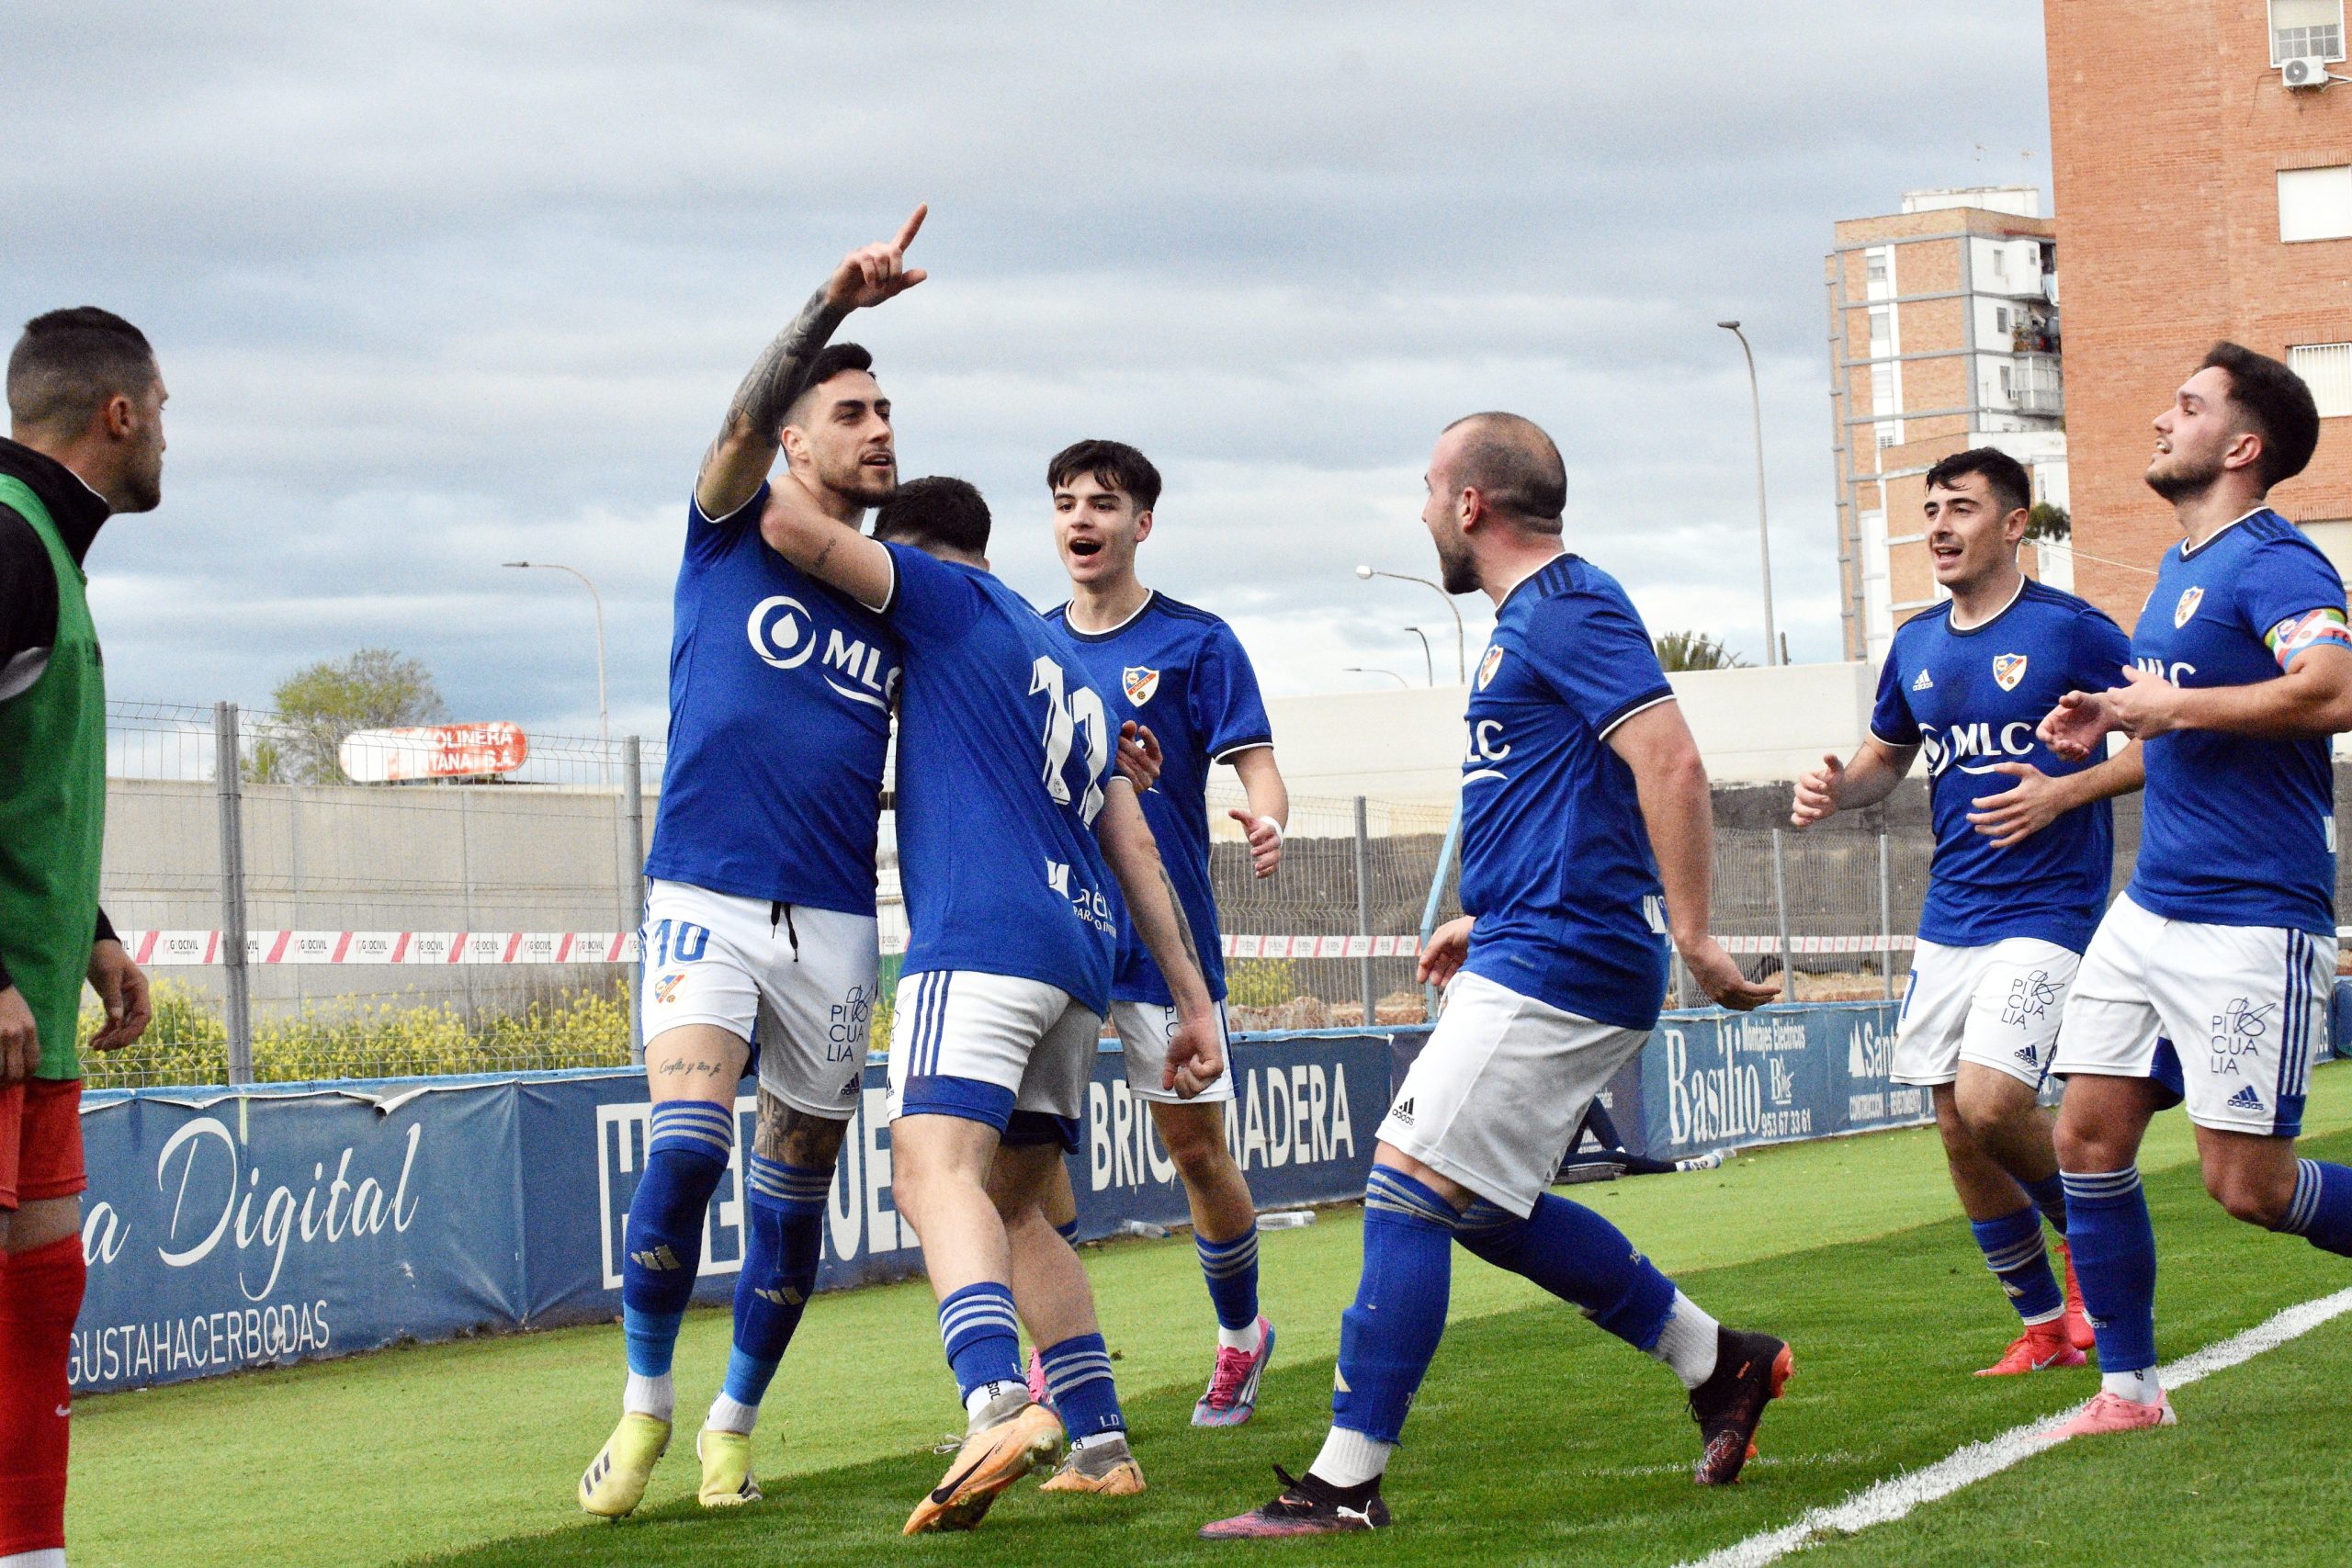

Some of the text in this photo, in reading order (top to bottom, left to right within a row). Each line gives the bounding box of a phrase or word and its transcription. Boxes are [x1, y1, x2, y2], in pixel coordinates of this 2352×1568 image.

[434, 727, 514, 749] OLINERA
[1028, 654, 1108, 831] 11
[1465, 719, 1511, 761] LC
[1951, 722, 2035, 757] MLC
[654, 919, 710, 967] 10
[2012, 978, 2028, 994] PI
[2001, 1008, 2027, 1030] LIA
[2008, 994, 2045, 1021] CUA
[2212, 1015, 2227, 1033] PI
[827, 1043, 854, 1062] LIA
[1864, 1021, 1894, 1078] Sant
[2211, 1035, 2259, 1056] CUA
[2211, 1056, 2240, 1076] LIA
[1664, 1023, 1761, 1145] Basilio
[1392, 1109, 1415, 1126] adidas
[2227, 1099, 2265, 1111] adidas
[1089, 1062, 1355, 1192] BRICMADERA
[1779, 1111, 1789, 1135] 67
[1791, 1110, 1801, 1134] 33
[1802, 1108, 1812, 1133] 61
[158, 1116, 422, 1302] Digital
[68, 1299, 330, 1385] GUSTAHACERBODAS
